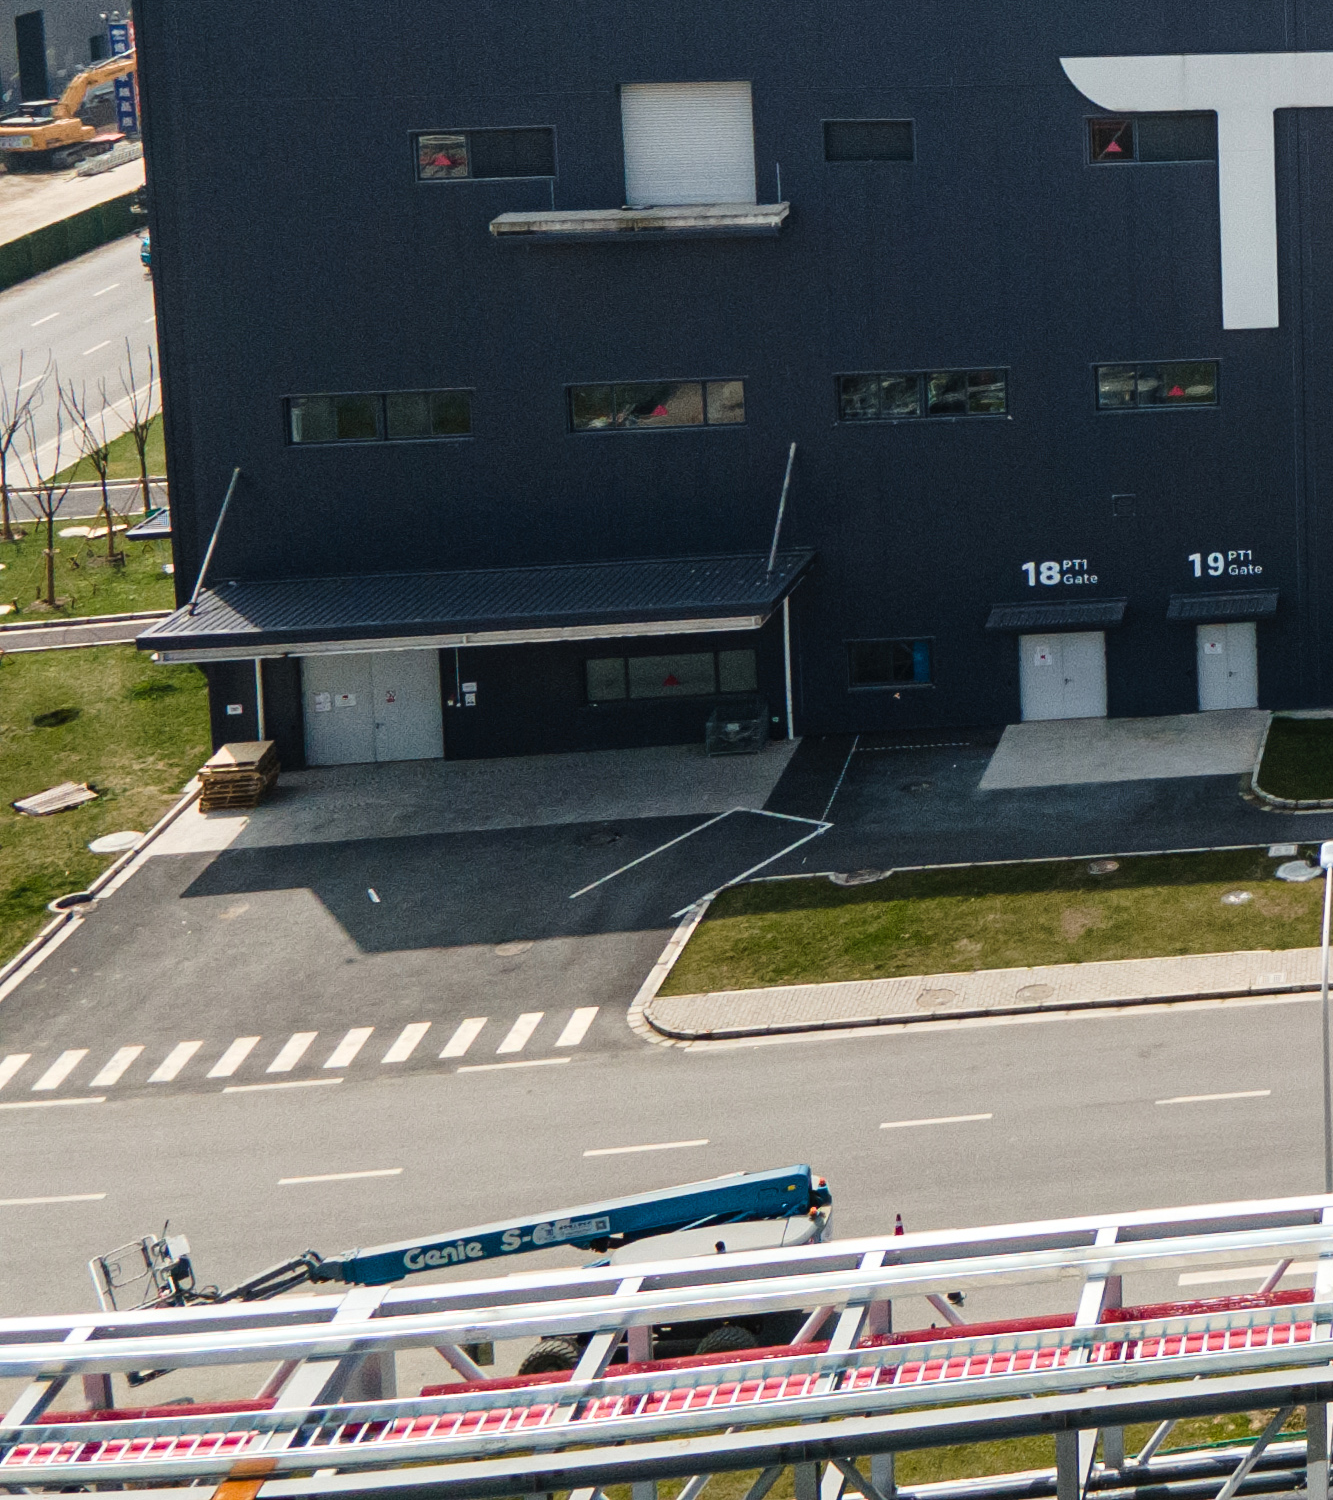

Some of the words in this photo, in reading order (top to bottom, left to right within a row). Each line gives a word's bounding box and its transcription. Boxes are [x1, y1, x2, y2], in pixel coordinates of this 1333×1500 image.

[1228, 550, 1252, 561] PT1
[1063, 559, 1087, 570] PT1
[1189, 553, 1224, 577] 19
[1229, 564, 1262, 575] Gate
[1022, 562, 1061, 586] 18
[1063, 574, 1098, 584] Gate
[404, 1241, 484, 1270] Genie
